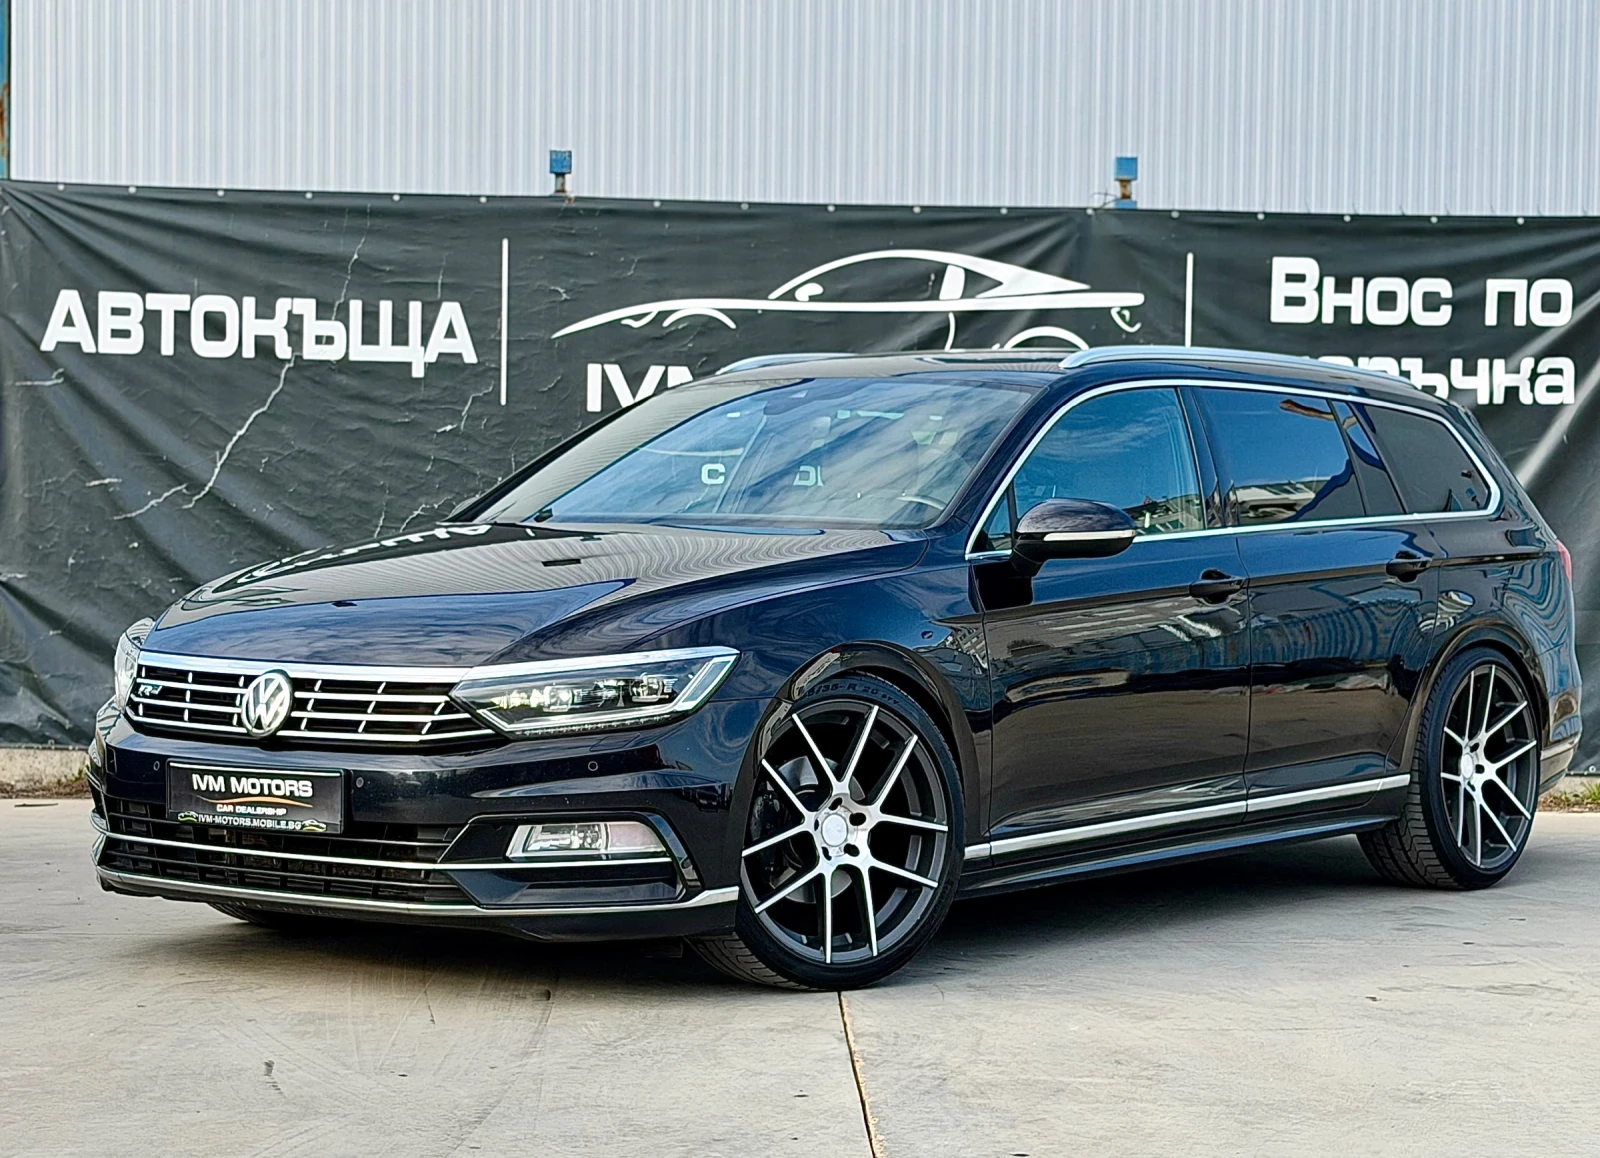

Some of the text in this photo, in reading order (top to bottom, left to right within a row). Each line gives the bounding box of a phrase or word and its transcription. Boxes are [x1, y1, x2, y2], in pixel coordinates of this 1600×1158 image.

[1270, 256, 1574, 328] Внос по
[40, 289, 478, 378] АВТОКЪЩА
[586, 363, 694, 412] IV
[192, 774, 313, 797] IVM MOTORS
[198, 814, 302, 829] IVM-MOTORS.MOBILE.BG
[216, 804, 287, 816] CAR DEALERSHIP
